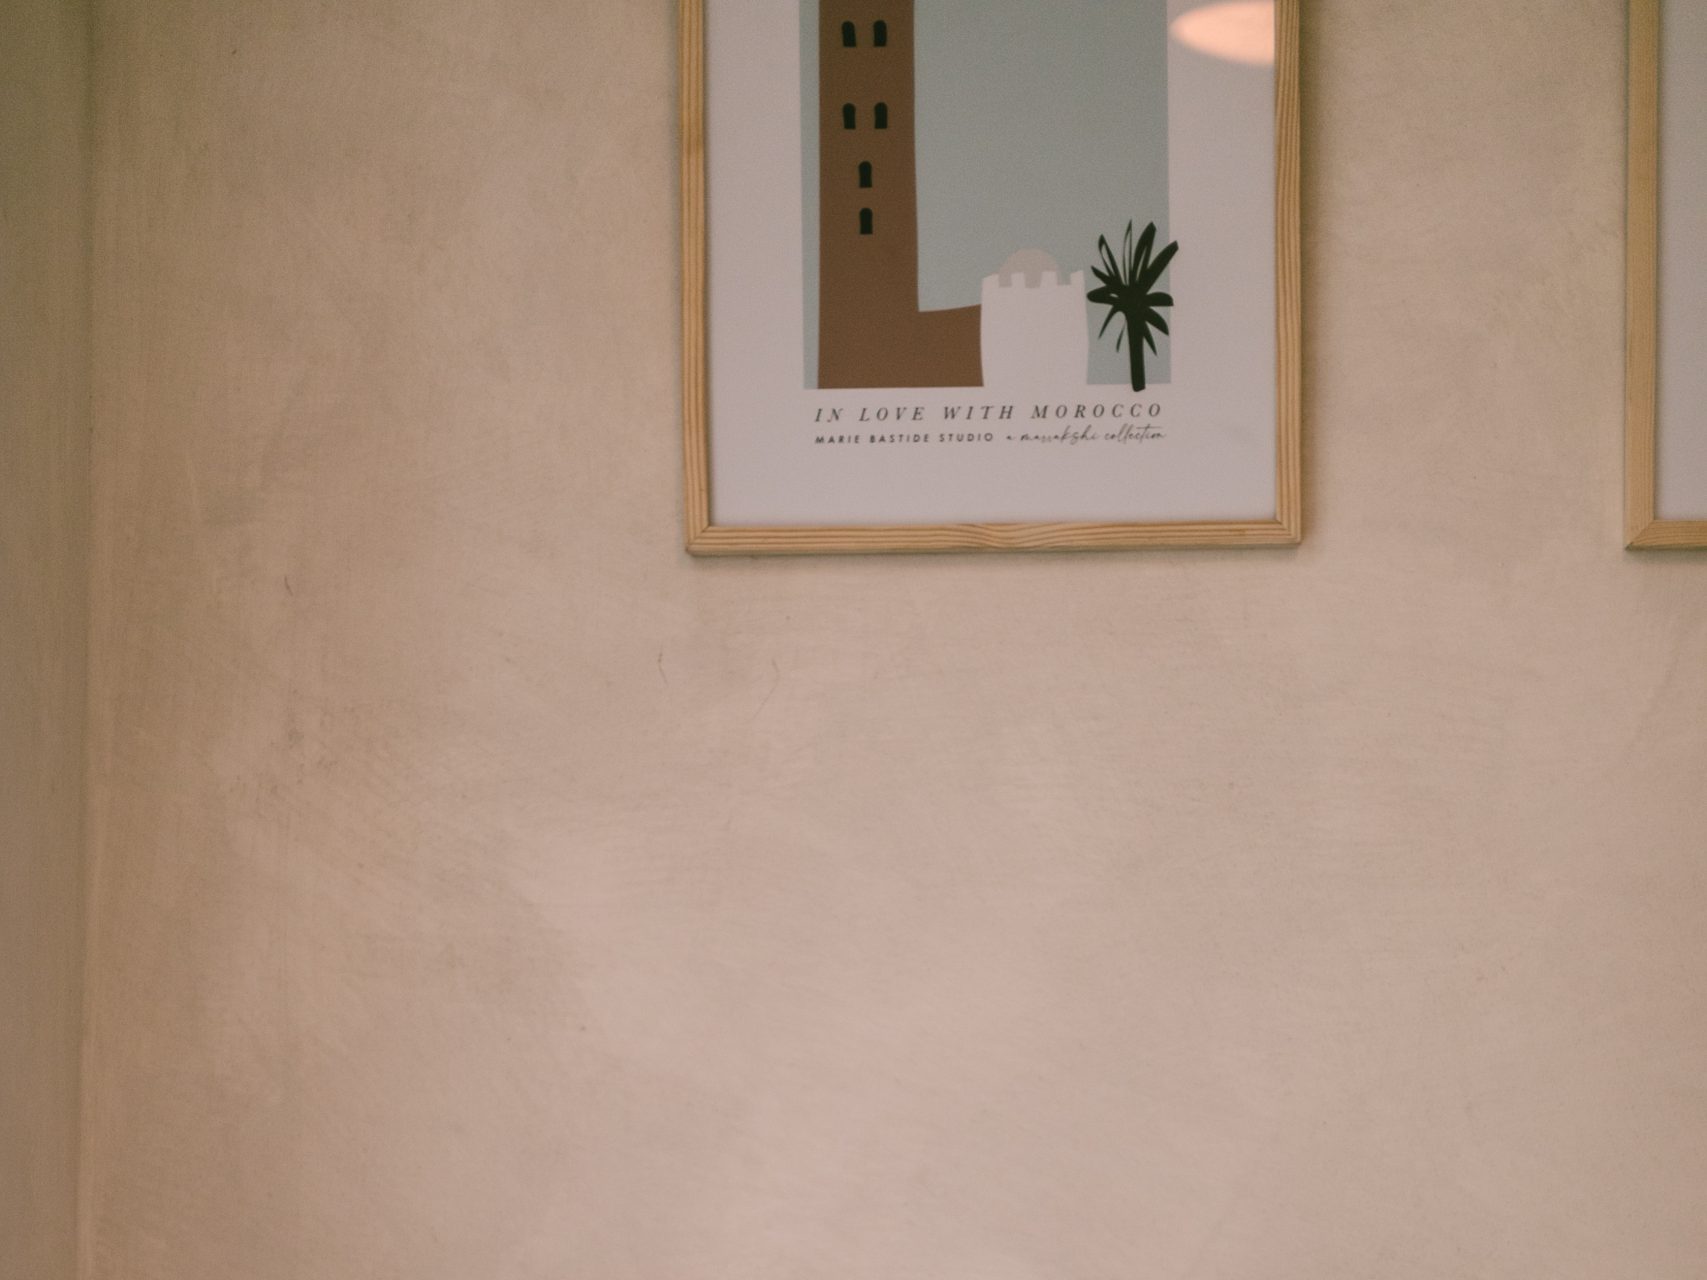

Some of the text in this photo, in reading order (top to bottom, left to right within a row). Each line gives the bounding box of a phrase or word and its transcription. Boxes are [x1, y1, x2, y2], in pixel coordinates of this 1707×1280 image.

[814, 403, 1161, 423] IN LOVE WITH MOROCCO
[814, 432, 994, 445] MARIE BASTIDE STUDIO
[1104, 423, 1168, 445] collection
